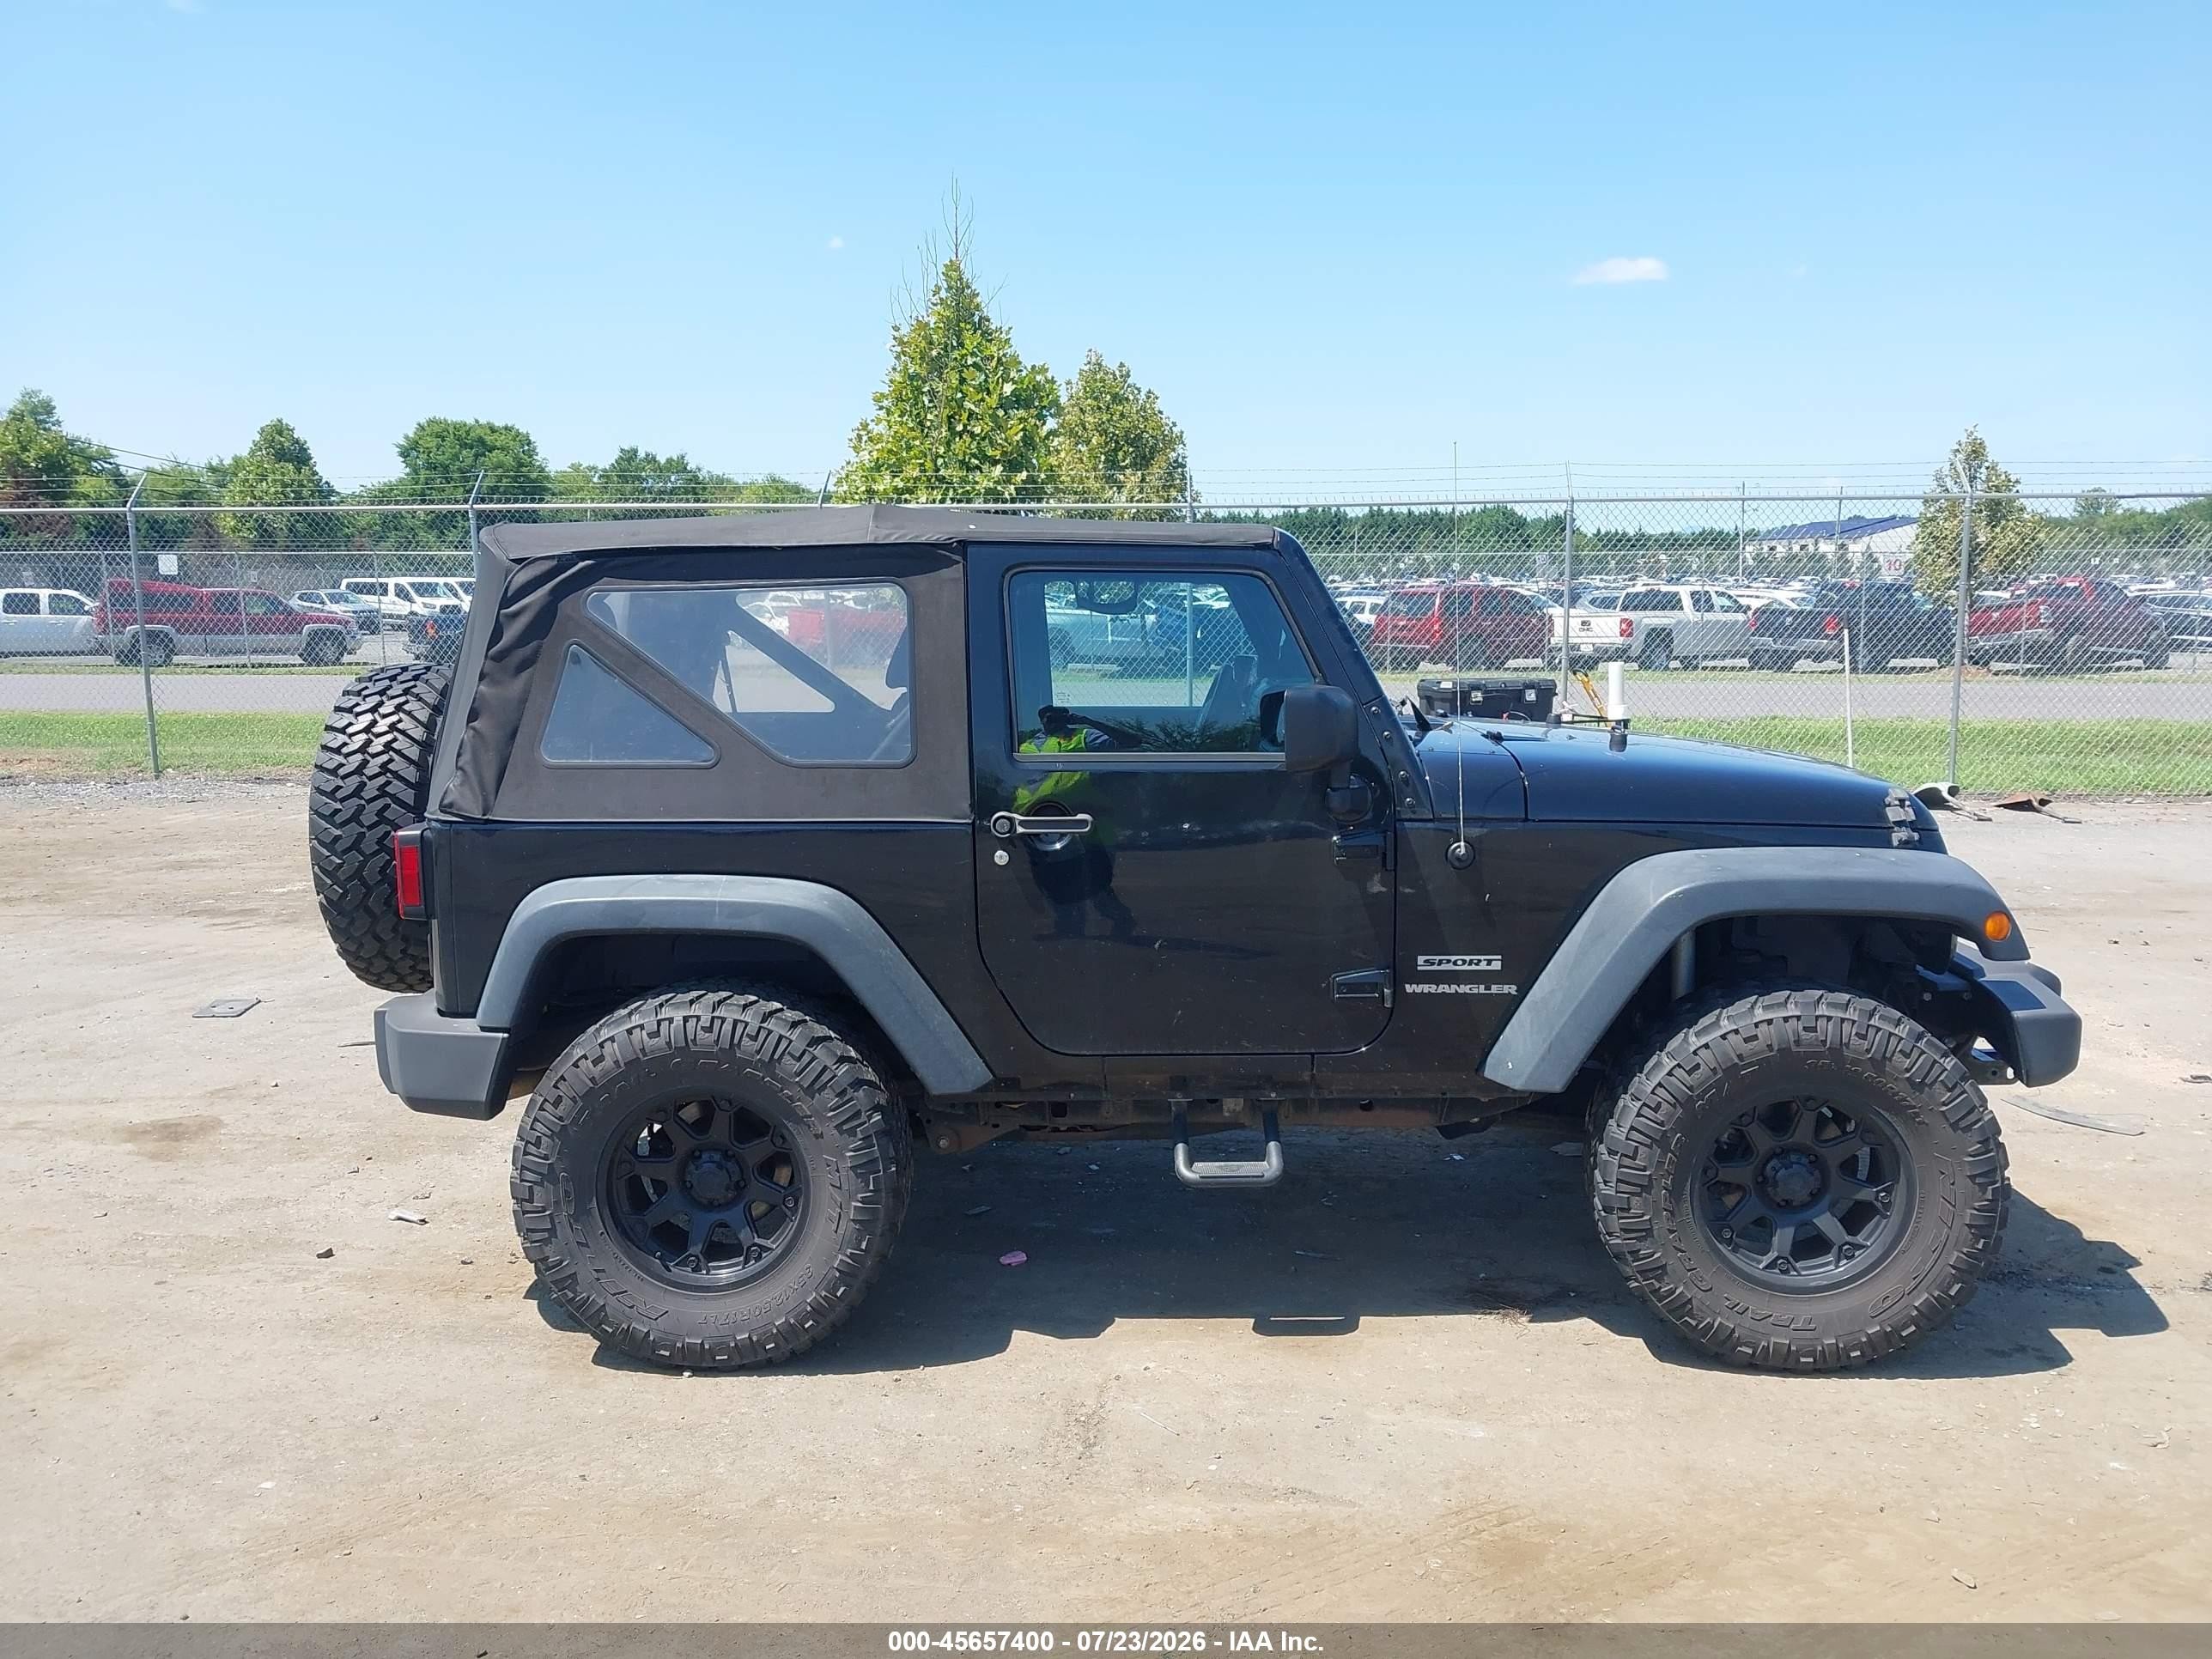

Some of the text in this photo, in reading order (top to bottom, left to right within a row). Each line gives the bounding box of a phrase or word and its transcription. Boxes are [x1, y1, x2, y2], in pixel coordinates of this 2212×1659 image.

[1419, 957, 1500, 967] SPORT
[1405, 983, 1517, 994] WRANGLER
[1662, 1133, 1713, 1291] GRAPPLER
[1868, 1152, 1957, 1318] NITTO
[1723, 1293, 1817, 1331] TRAIL
